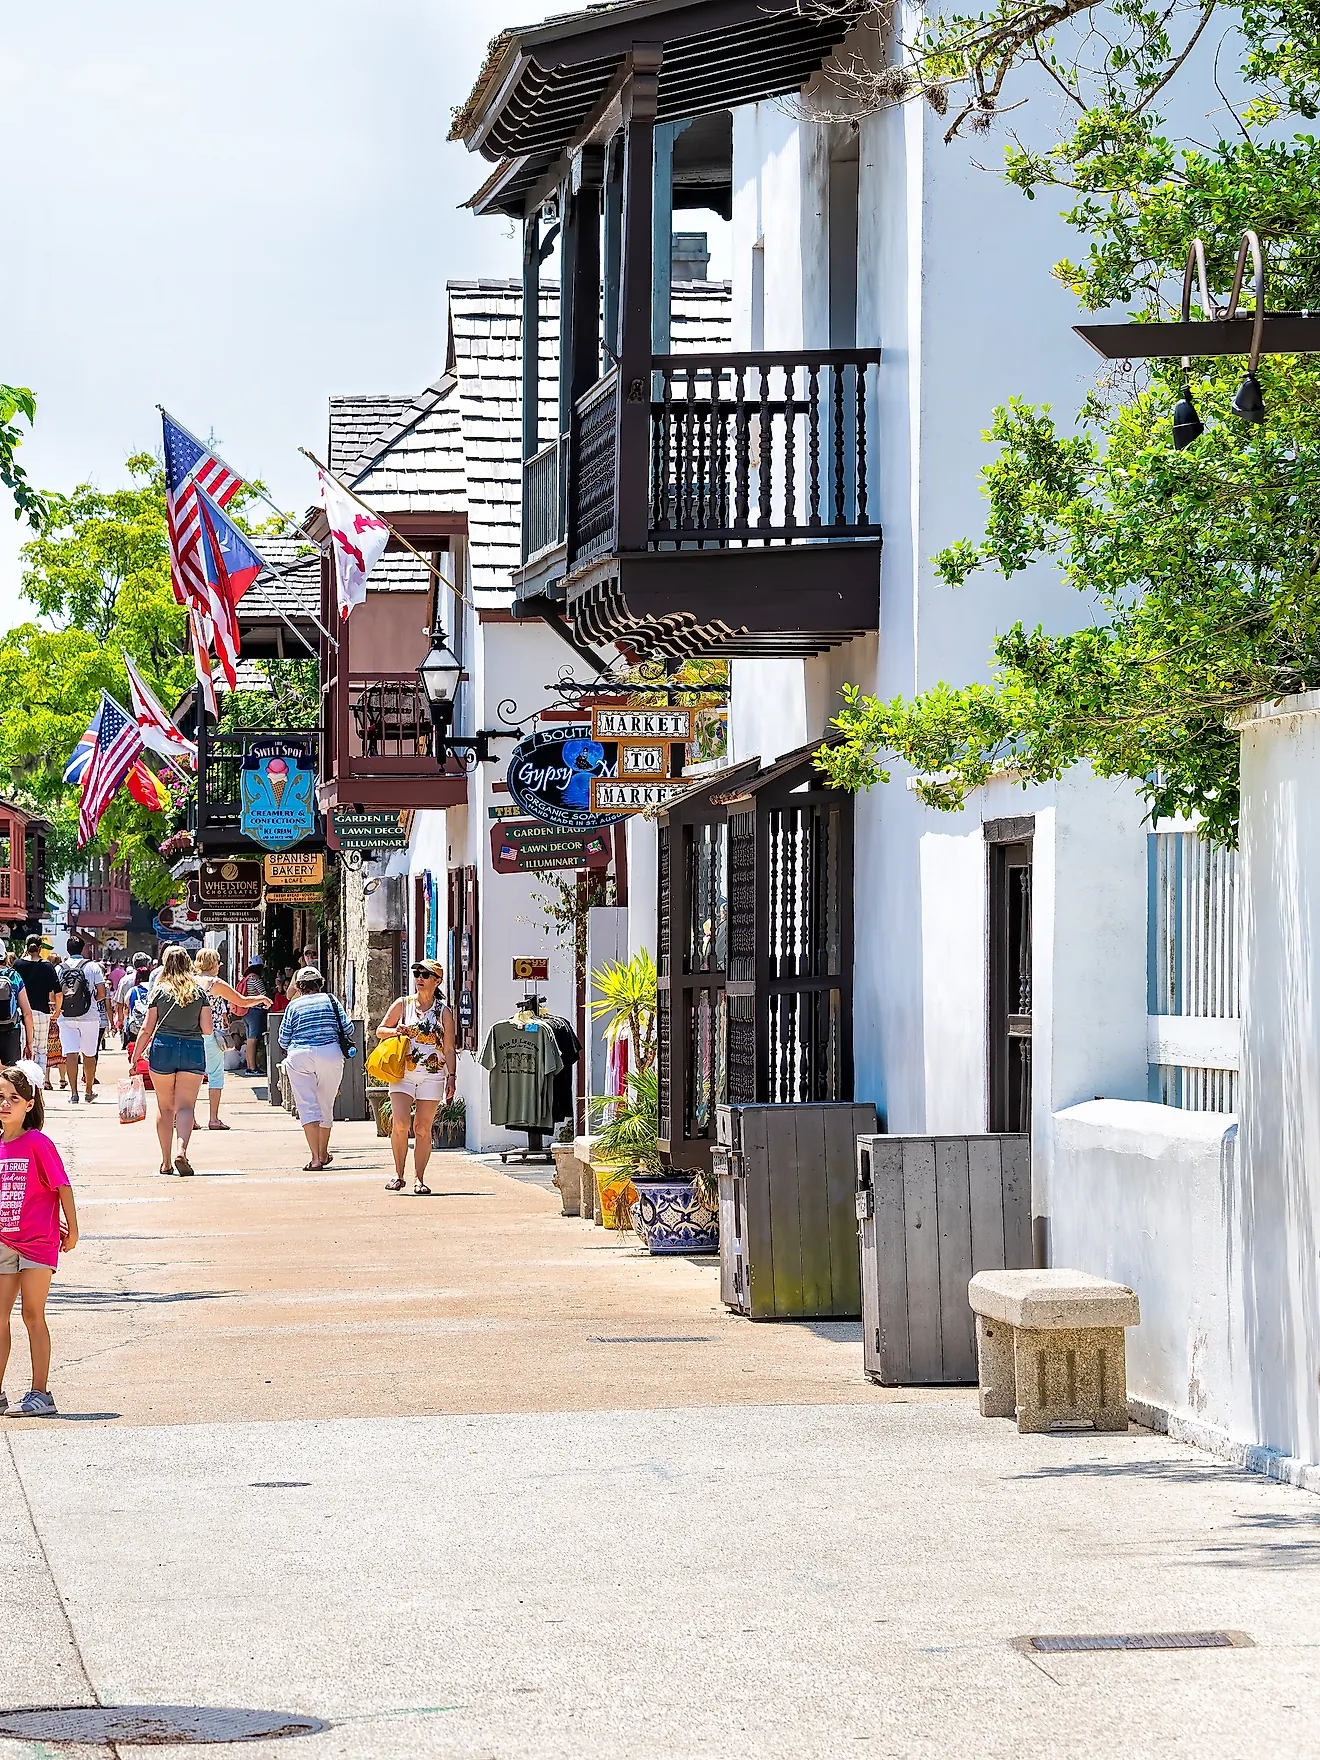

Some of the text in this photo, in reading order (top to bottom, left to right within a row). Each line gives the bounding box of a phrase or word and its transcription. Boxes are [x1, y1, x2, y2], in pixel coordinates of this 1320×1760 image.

[603, 716, 682, 732] MARKET
[282, 745, 303, 758] SPOT
[631, 753, 655, 767] TO
[518, 762, 573, 791] Gypsy
[495, 806, 520, 816] THE
[337, 815, 381, 823] GARDEN
[341, 827, 372, 835] LAWN
[513, 827, 554, 838] GARDEN
[346, 840, 406, 848] ILLUMINART
[522, 841, 581, 854] LAWN DECOR
[269, 854, 318, 863] SPANISH
[525, 856, 579, 869] ILLUMINART
[272, 865, 315, 876] BAKERY
[204, 881, 258, 890] WHETSTONE
